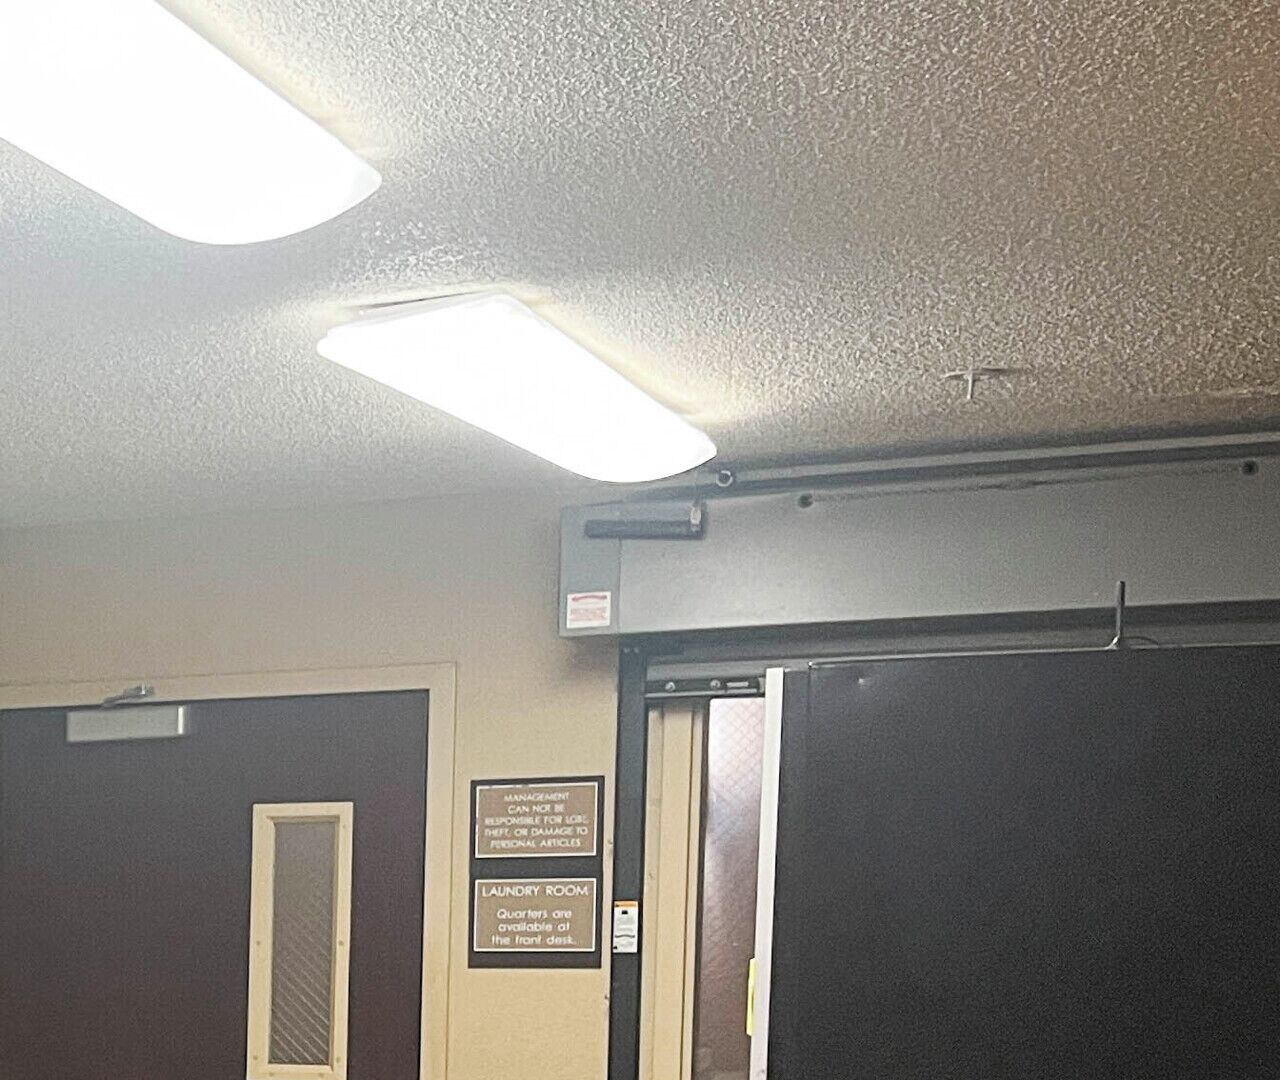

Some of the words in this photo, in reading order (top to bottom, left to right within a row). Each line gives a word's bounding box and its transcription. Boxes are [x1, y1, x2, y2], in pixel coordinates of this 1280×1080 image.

[504, 791, 569, 802] MANAGEMENT
[507, 804, 529, 815] CAN
[532, 804, 551, 813] NOT
[554, 803, 564, 812] BE
[484, 815, 541, 826] RESPONSIBLE
[544, 815, 562, 824] FOR
[514, 828, 528, 836] OR
[531, 827, 574, 836] DAMAGE
[576, 826, 588, 835] TO
[490, 840, 536, 849] PERSONAL
[482, 885, 540, 897] LAUNDRY
[546, 885, 589, 896] ROOM
[497, 909, 548, 919] Quarters
[552, 910, 572, 919] are
[498, 922, 553, 932] available
[557, 922, 570, 932] at
[492, 935, 511, 945] the
[515, 935, 542, 945] front
[546, 935, 577, 945] desk.
